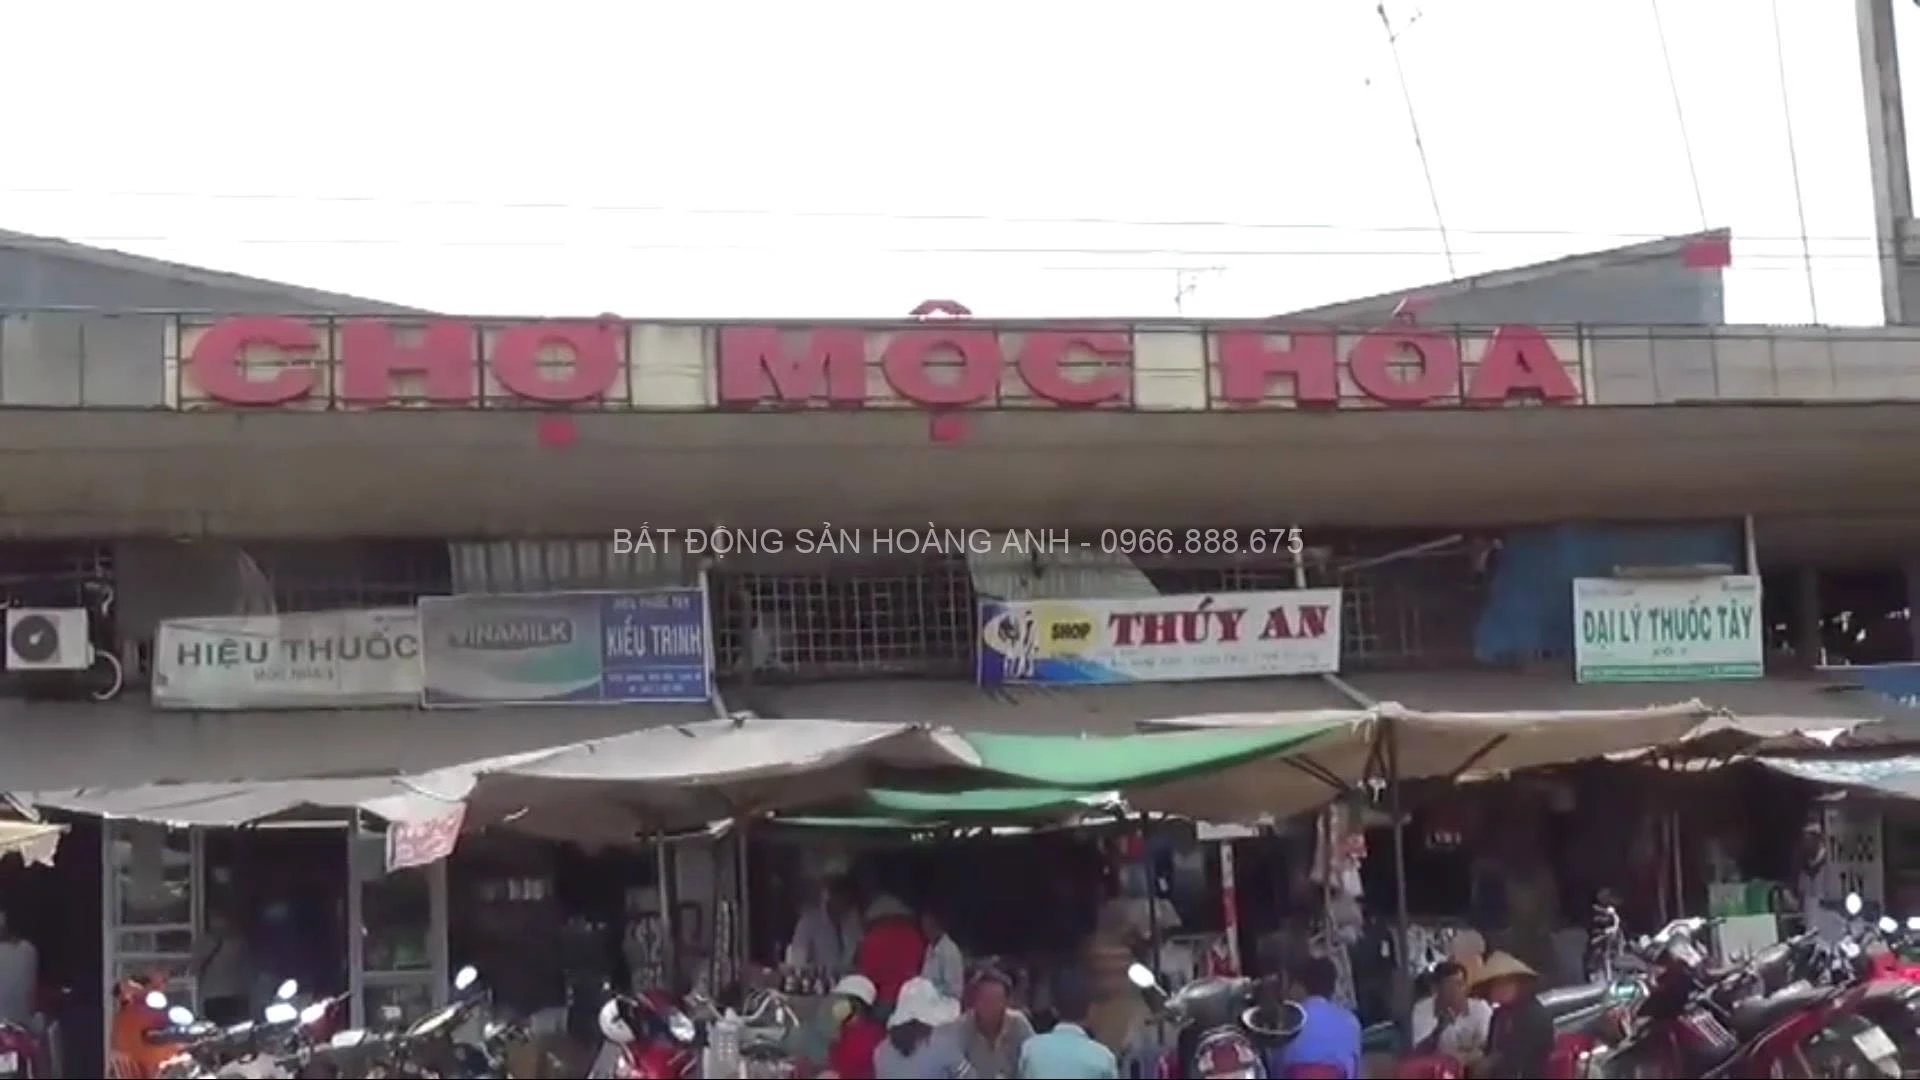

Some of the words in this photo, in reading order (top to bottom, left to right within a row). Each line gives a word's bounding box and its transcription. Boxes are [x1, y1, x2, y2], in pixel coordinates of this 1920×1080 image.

[188, 312, 624, 450] CHỢ
[720, 299, 1133, 443] MỘC
[177, 637, 269, 670] HIỆU
[281, 624, 418, 664] THUỐC
[1051, 621, 1091, 642] SHOP
[1107, 597, 1249, 646] THÚY
[1258, 604, 1331, 642] AN
[1582, 609, 1615, 650] ĐẠI
[1619, 602, 1642, 643] LÝ
[1647, 595, 1712, 642] THUỐC
